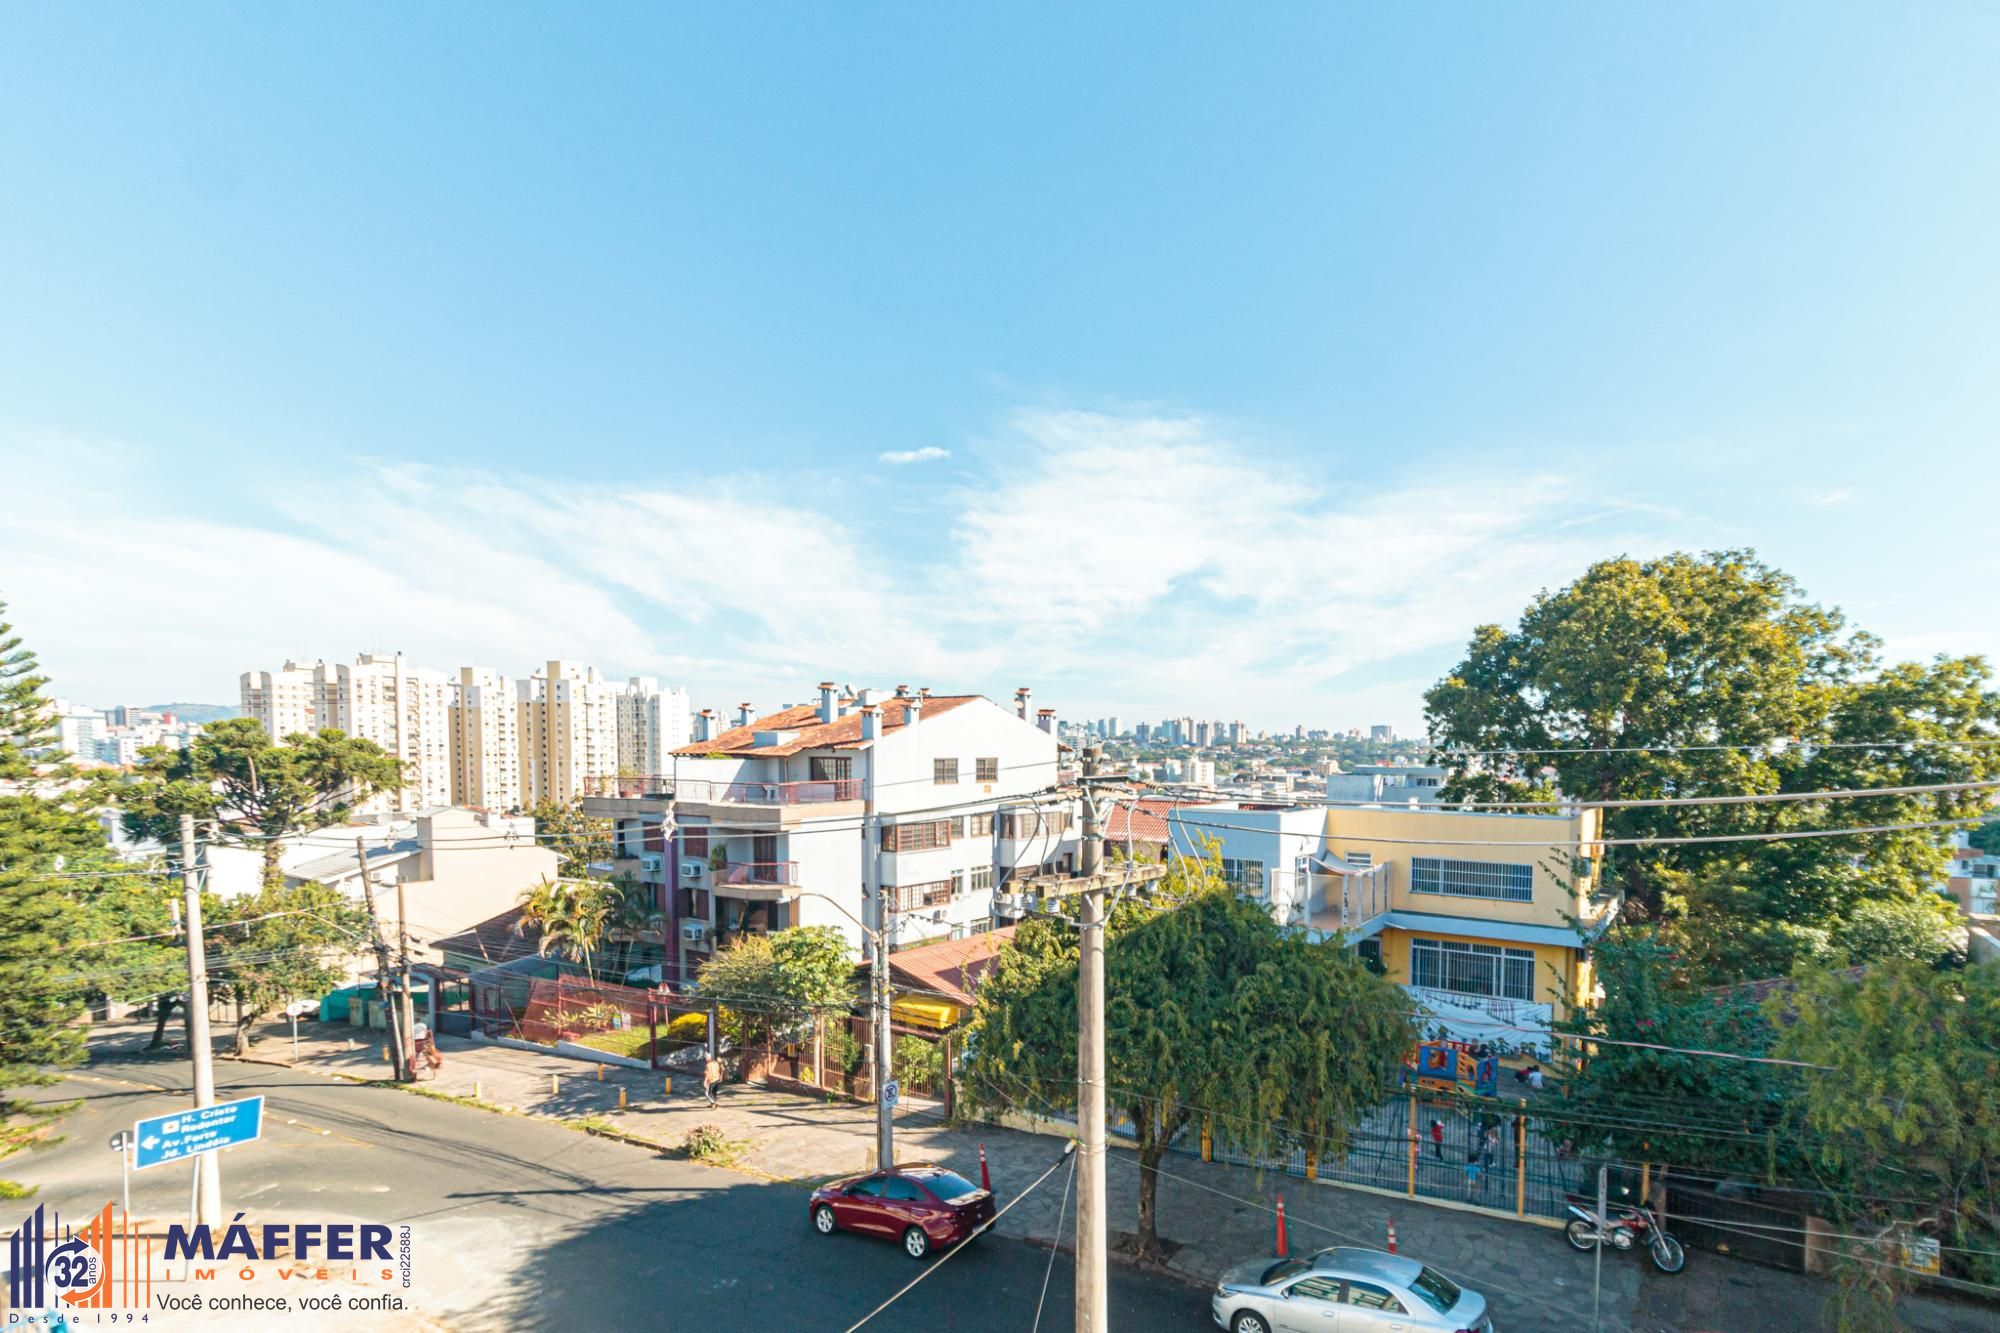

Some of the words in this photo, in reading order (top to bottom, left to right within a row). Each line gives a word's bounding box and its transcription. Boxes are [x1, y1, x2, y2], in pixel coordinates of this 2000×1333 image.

[181, 1114, 196, 1124] H.
[200, 1105, 239, 1120] Cristo
[180, 1115, 237, 1134] Redentor
